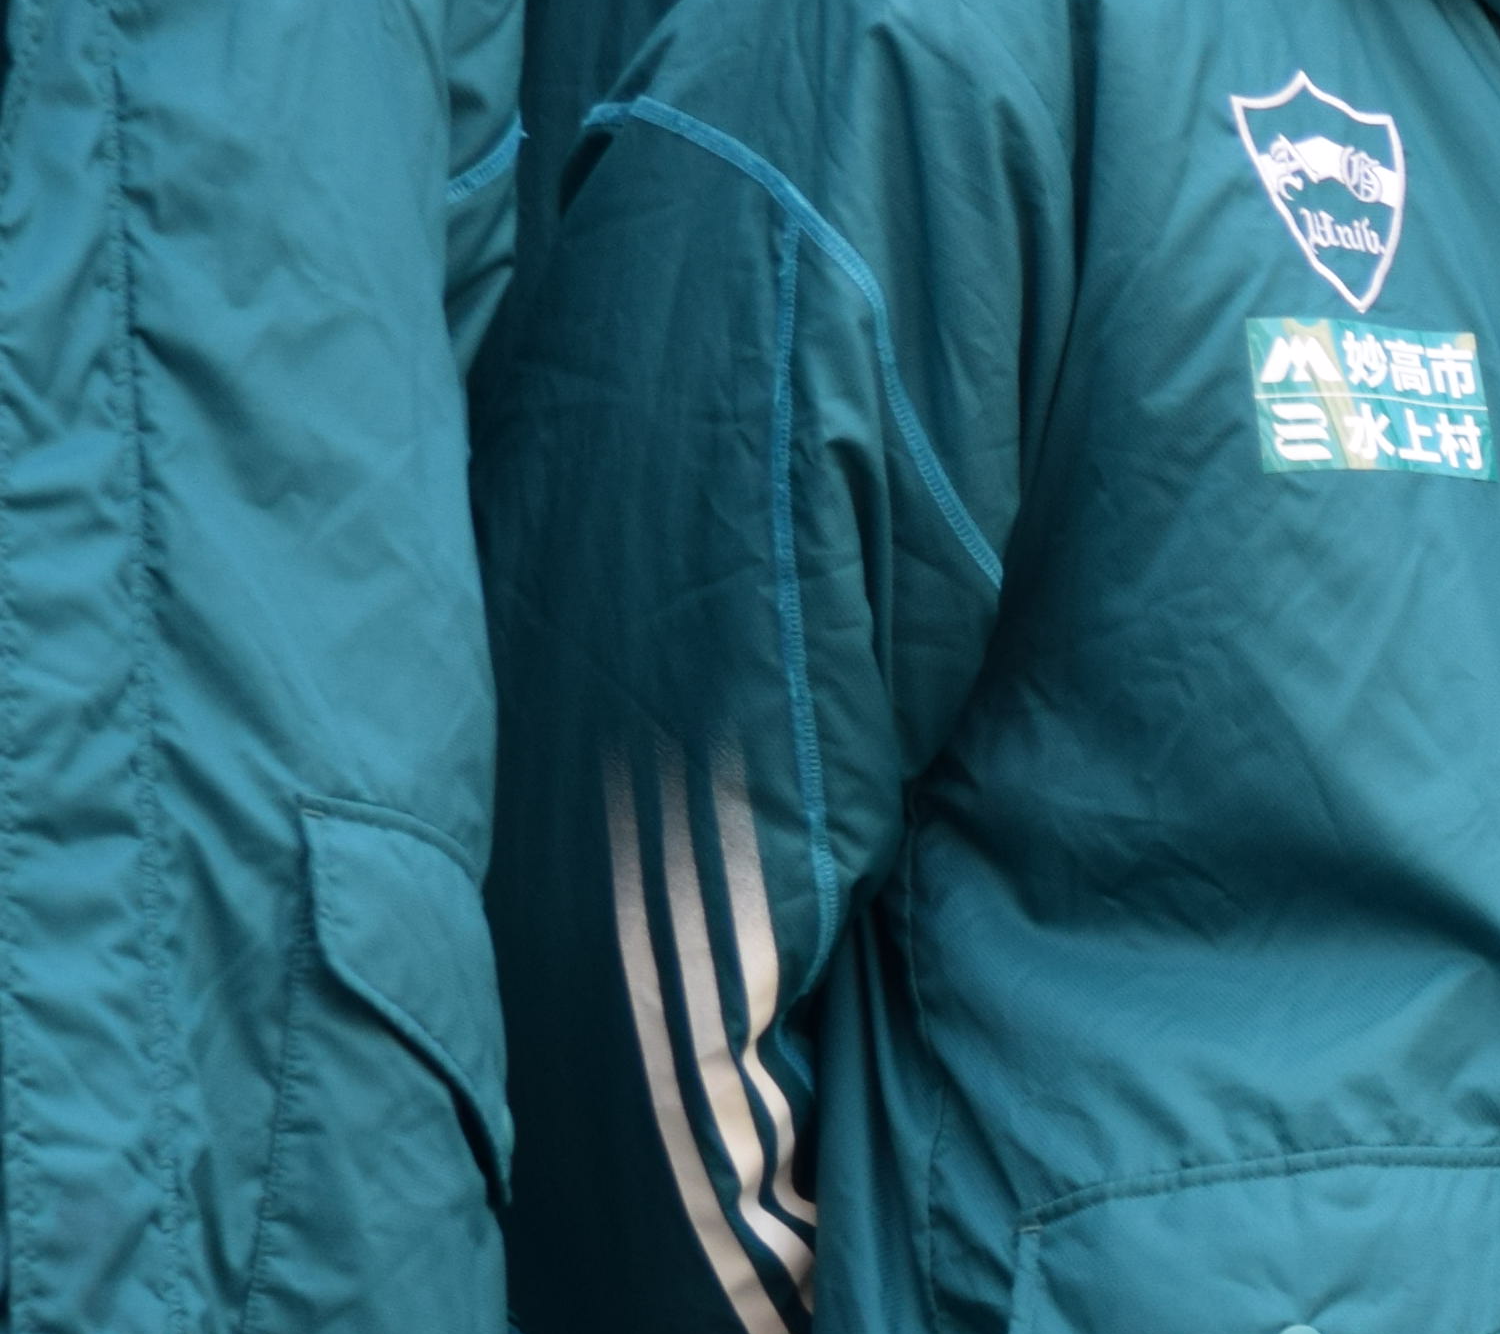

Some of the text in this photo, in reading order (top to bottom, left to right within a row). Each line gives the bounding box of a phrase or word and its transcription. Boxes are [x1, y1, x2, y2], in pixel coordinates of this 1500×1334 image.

[1341, 331, 1476, 400] 妙高市
[1344, 403, 1483, 470] 水上村
